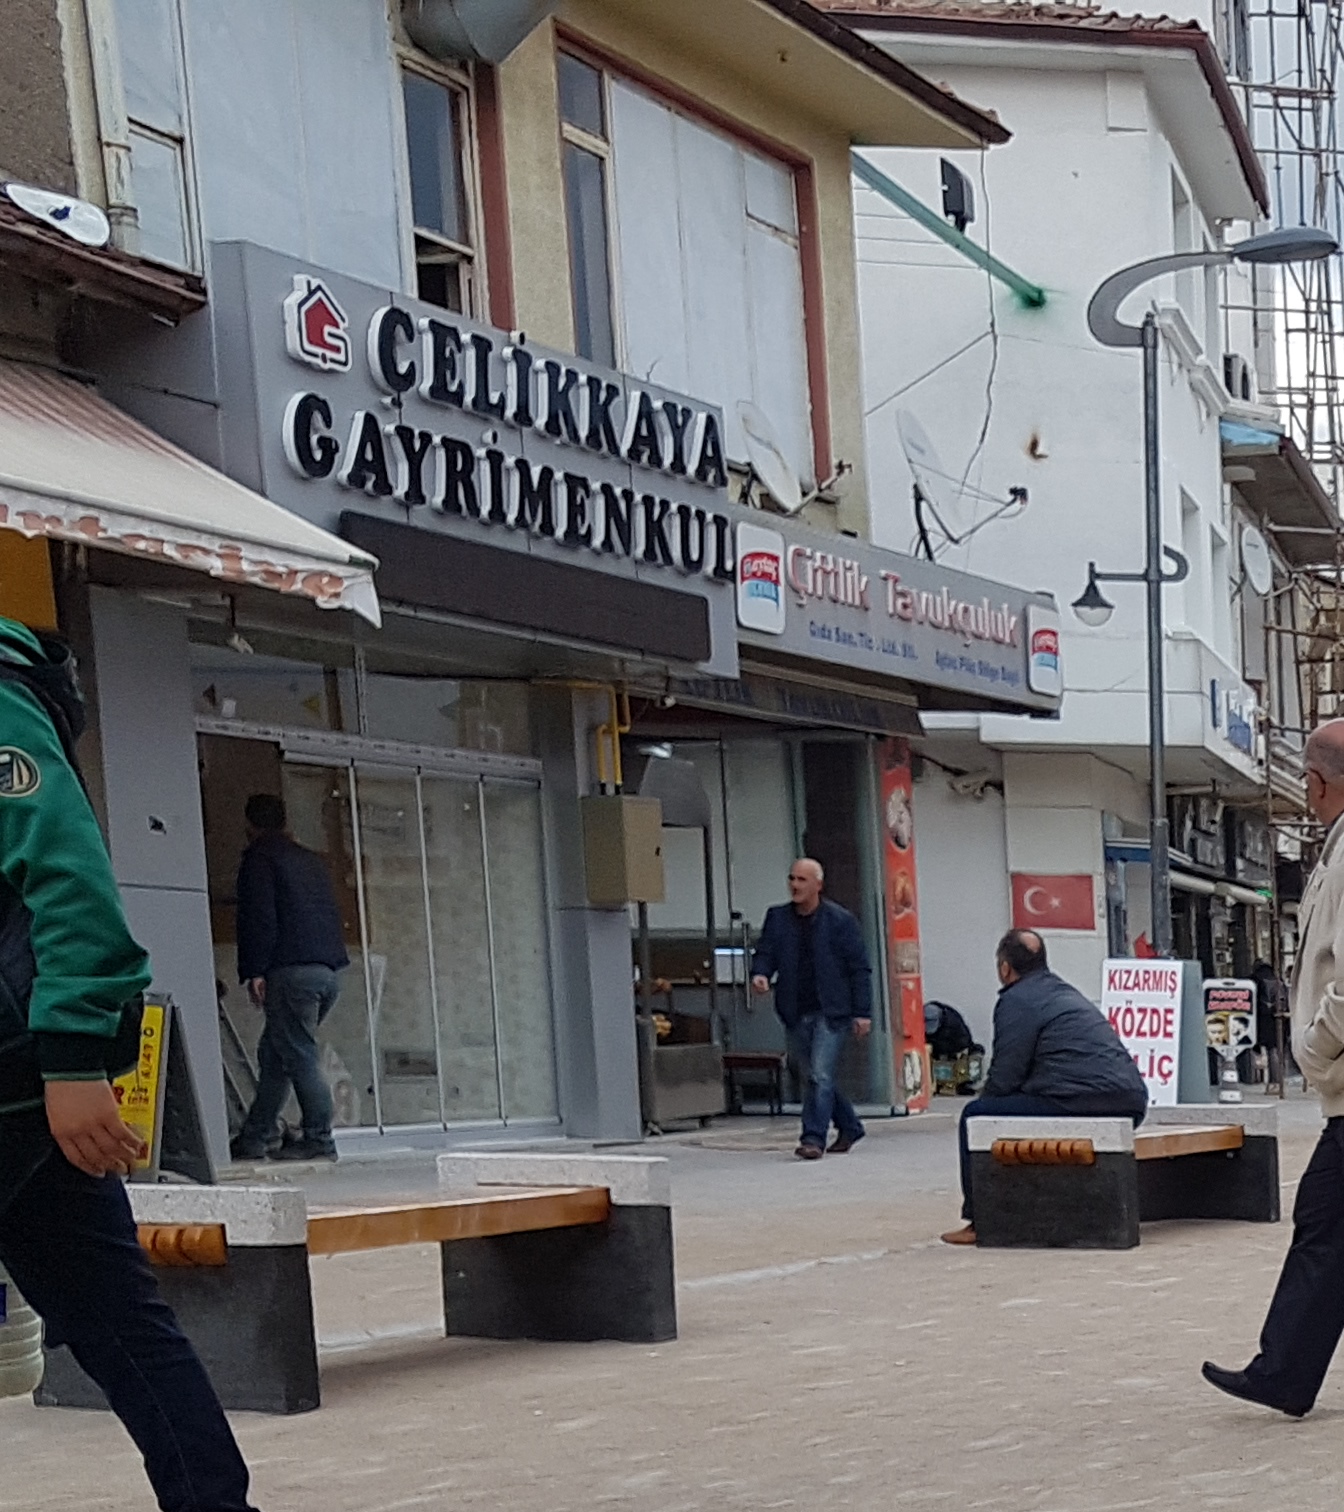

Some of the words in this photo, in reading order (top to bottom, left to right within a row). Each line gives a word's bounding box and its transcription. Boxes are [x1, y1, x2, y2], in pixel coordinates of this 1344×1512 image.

[367, 305, 729, 488] ÇELİKKAYA
[282, 391, 737, 582] GAYRİMENKUL
[787, 545, 869, 609] Çiftlik
[879, 569, 1019, 648] Tavukçuluk
[1107, 968, 1178, 999] KIZARMIŞ
[1108, 1000, 1174, 1039] KÖZDE
[1132, 1048, 1174, 1086] LİÇ
